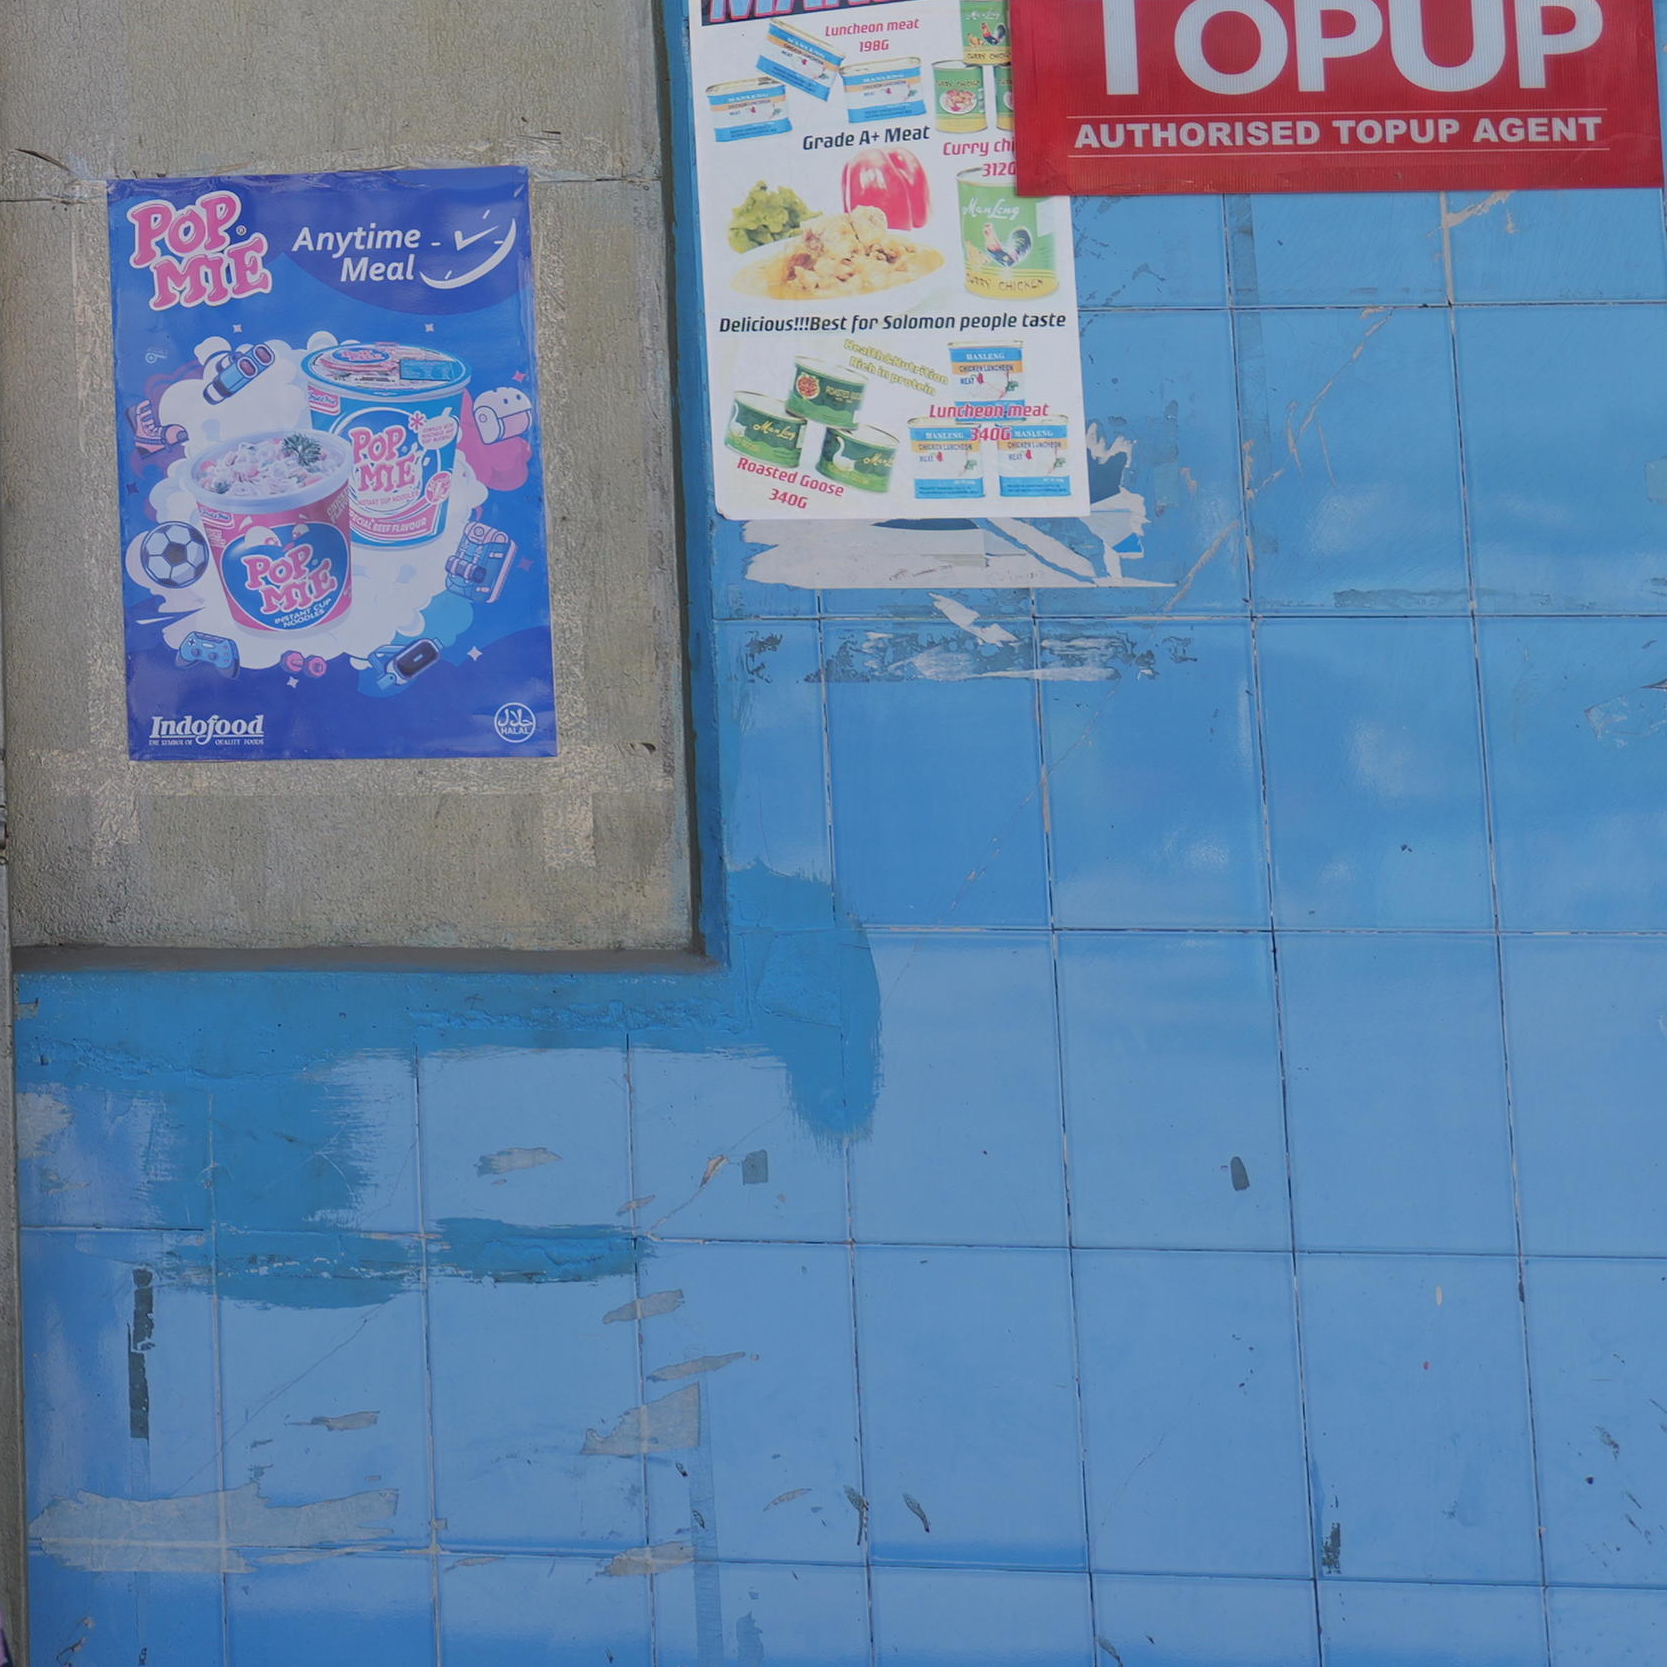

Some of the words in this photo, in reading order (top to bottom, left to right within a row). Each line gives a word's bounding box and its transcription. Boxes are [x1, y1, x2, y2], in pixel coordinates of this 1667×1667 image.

[825, 21, 883, 37] Luncheon
[887, 19, 920, 32] meat
[859, 39, 889, 52] 198G
[803, 133, 855, 150] Grade
[860, 131, 880, 147] A+
[885, 126, 930, 144] Meat
[1074, 120, 1320, 149] AUTHORISED
[1333, 118, 1459, 145] TOPUP
[1473, 116, 1602, 143] AGENT
[943, 141, 989, 160] Curry
[126, 191, 242, 267] POP
[292, 225, 421, 256] Anytime
[148, 232, 272, 312] MIE
[340, 257, 414, 283] Meal
[851, 315, 878, 332] for
[883, 314, 956, 330] Solomon
[960, 313, 1017, 331] people
[1022, 312, 1066, 328] taste
[929, 404, 1007, 418] Luncheon
[1009, 403, 1049, 417] meat
[348, 424, 406, 465] POP
[971, 427, 1013, 441] 340G
[356, 453, 417, 494] MIE
[737, 457, 798, 484] Roasted
[800, 474, 844, 498] Goose
[768, 488, 809, 510] 340G
[240, 543, 313, 591] POP
[259, 557, 339, 615] MIE
[149, 714, 264, 745] Indofood
